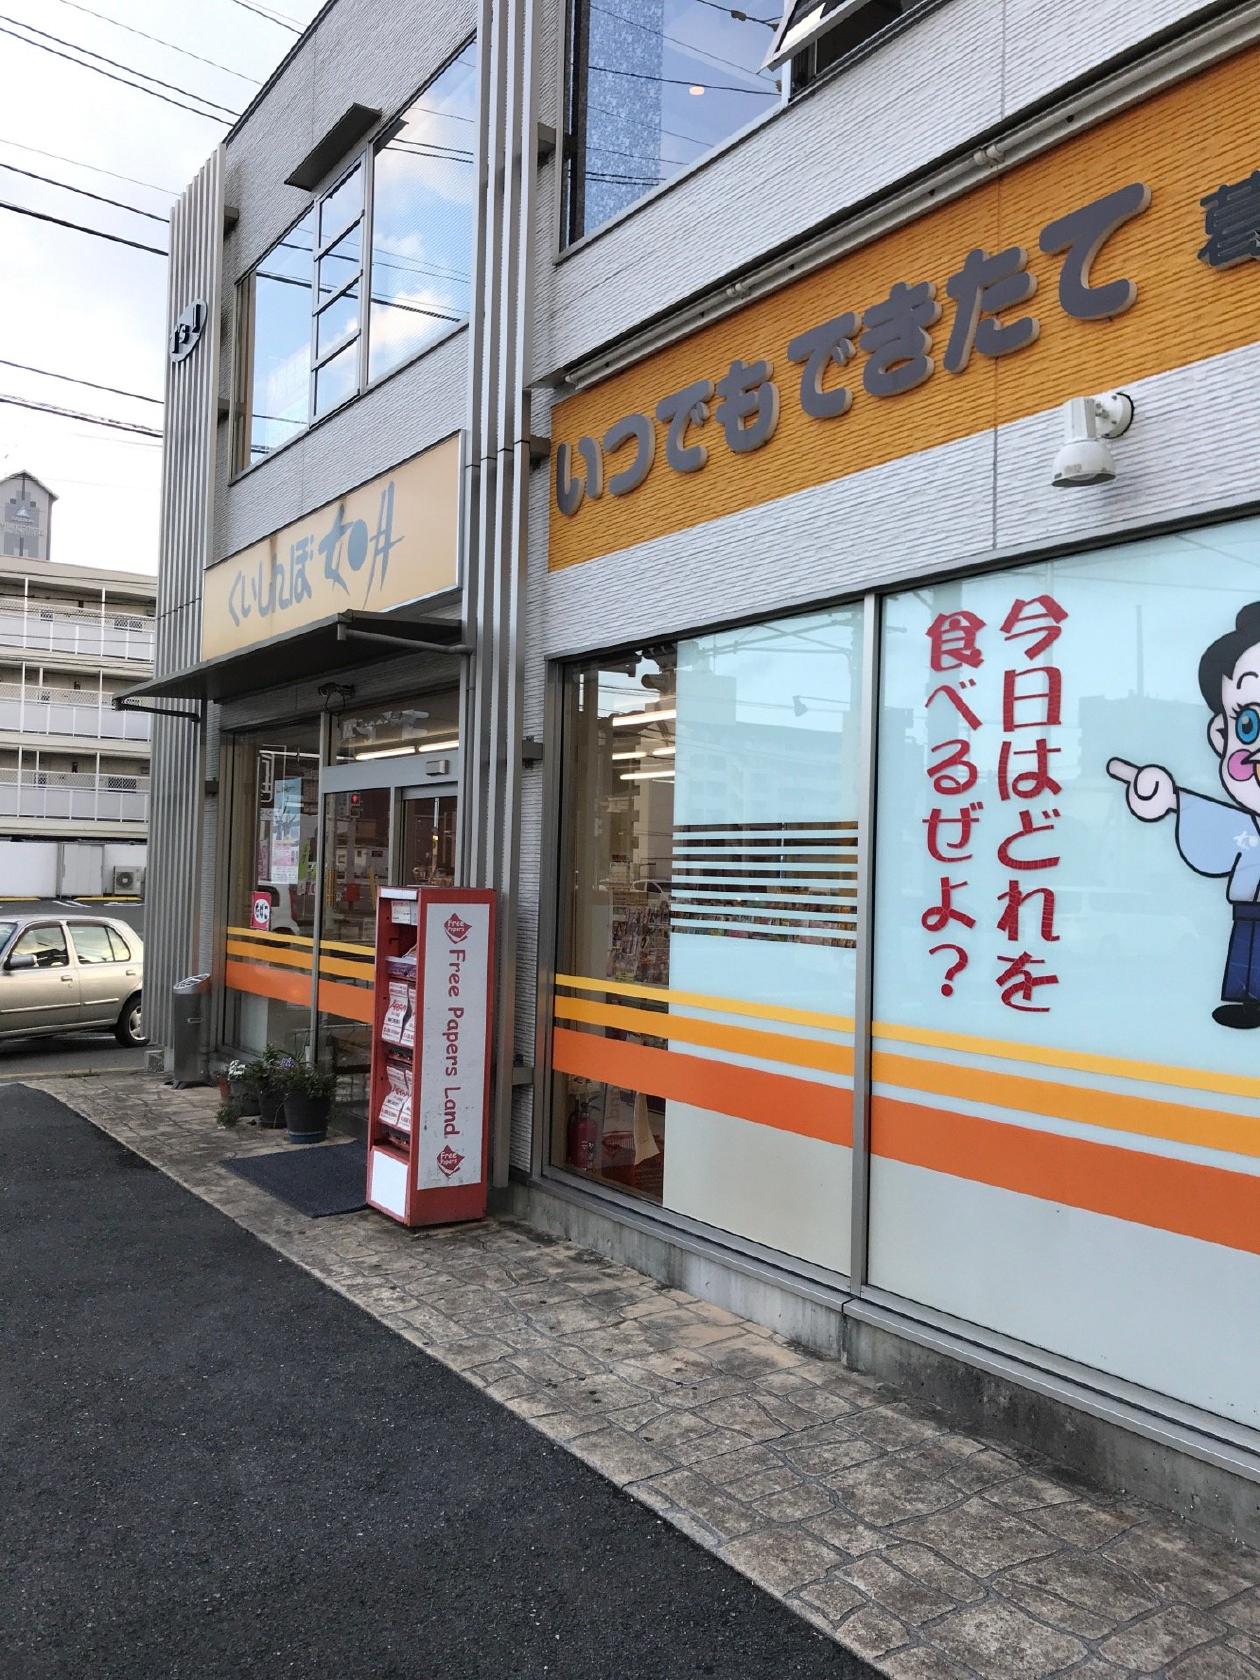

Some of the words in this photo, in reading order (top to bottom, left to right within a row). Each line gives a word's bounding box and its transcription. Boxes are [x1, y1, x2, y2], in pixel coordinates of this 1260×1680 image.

[556, 182, 1152, 515] いつでもできたて
[996, 595, 1068, 1012] 今日はどれを
[447, 919, 465, 928] Free
[449, 949, 465, 997] Free
[442, 1007, 464, 1076] Papers
[444, 1087, 461, 1136] Land
[440, 1151, 458, 1159] Free
